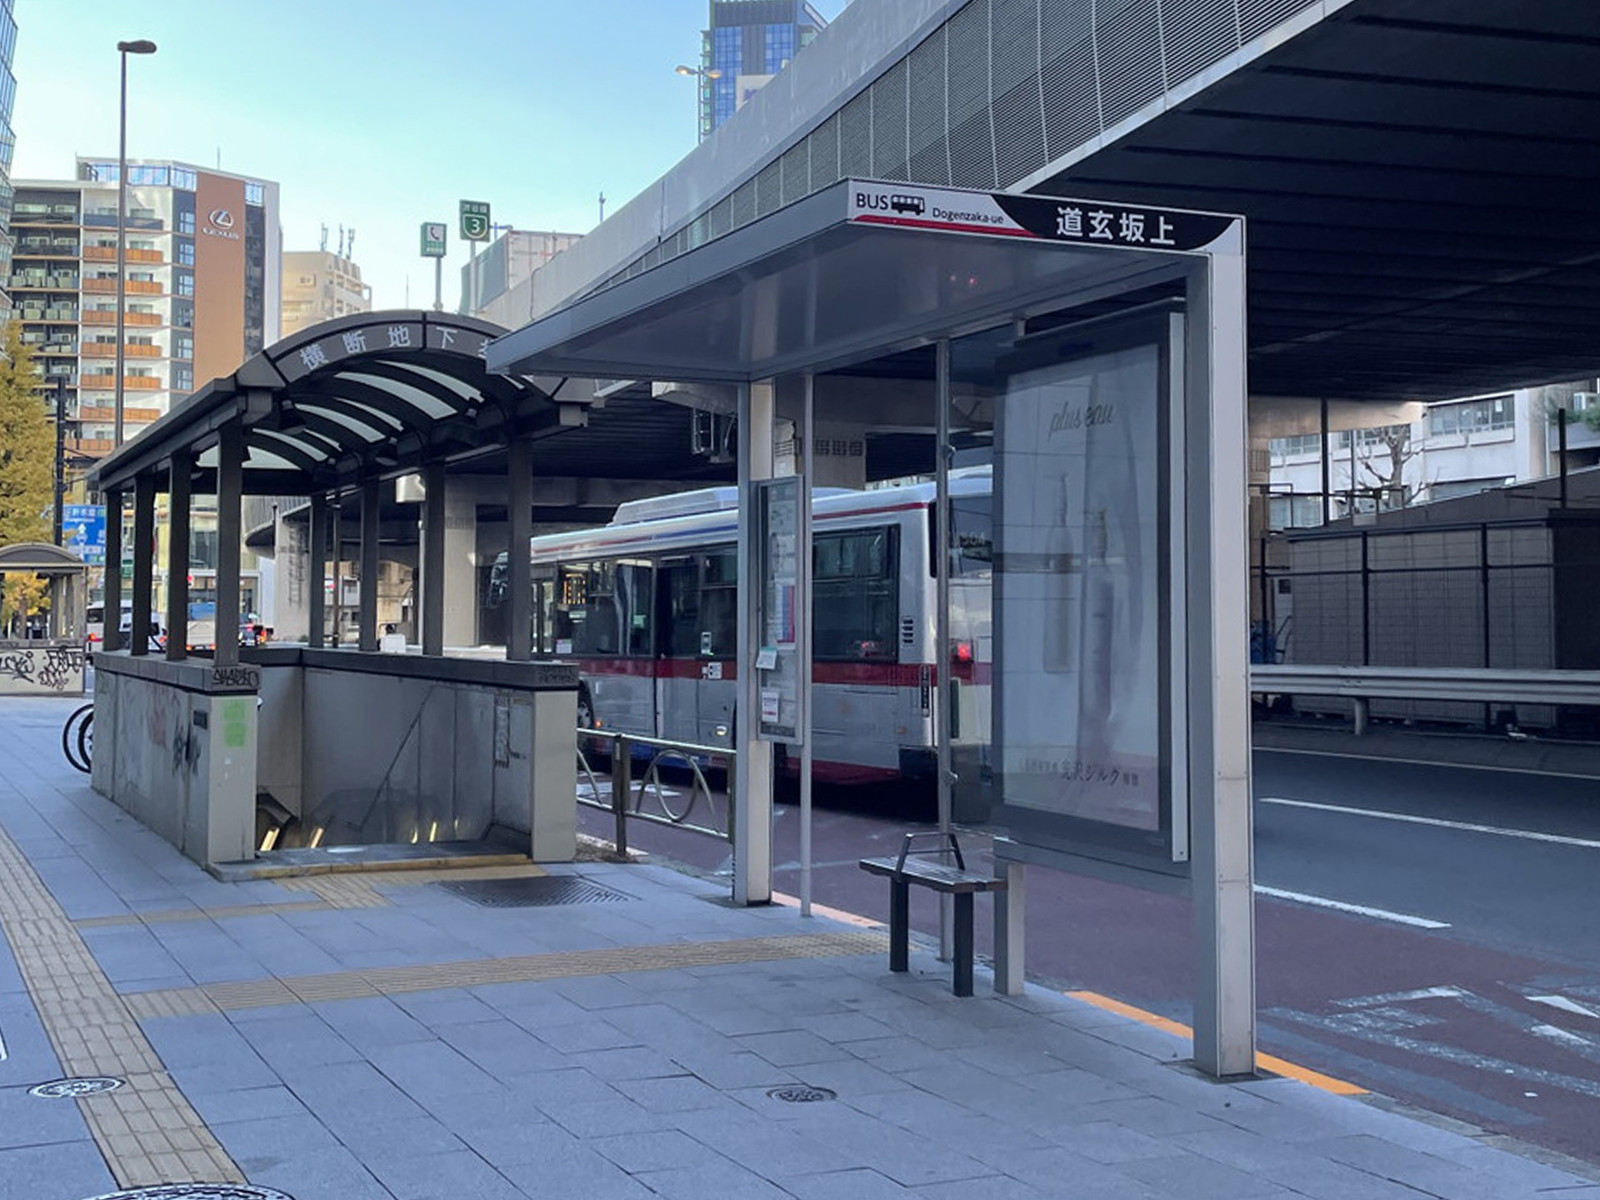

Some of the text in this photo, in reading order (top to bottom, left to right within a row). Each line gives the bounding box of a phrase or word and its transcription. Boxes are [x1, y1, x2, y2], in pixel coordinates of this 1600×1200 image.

[856, 192, 889, 211] BUS
[932, 207, 1005, 225] Dogenzaka-ue
[471, 218, 480, 234] 3
[1056, 206, 1176, 246] 道玄坂上
